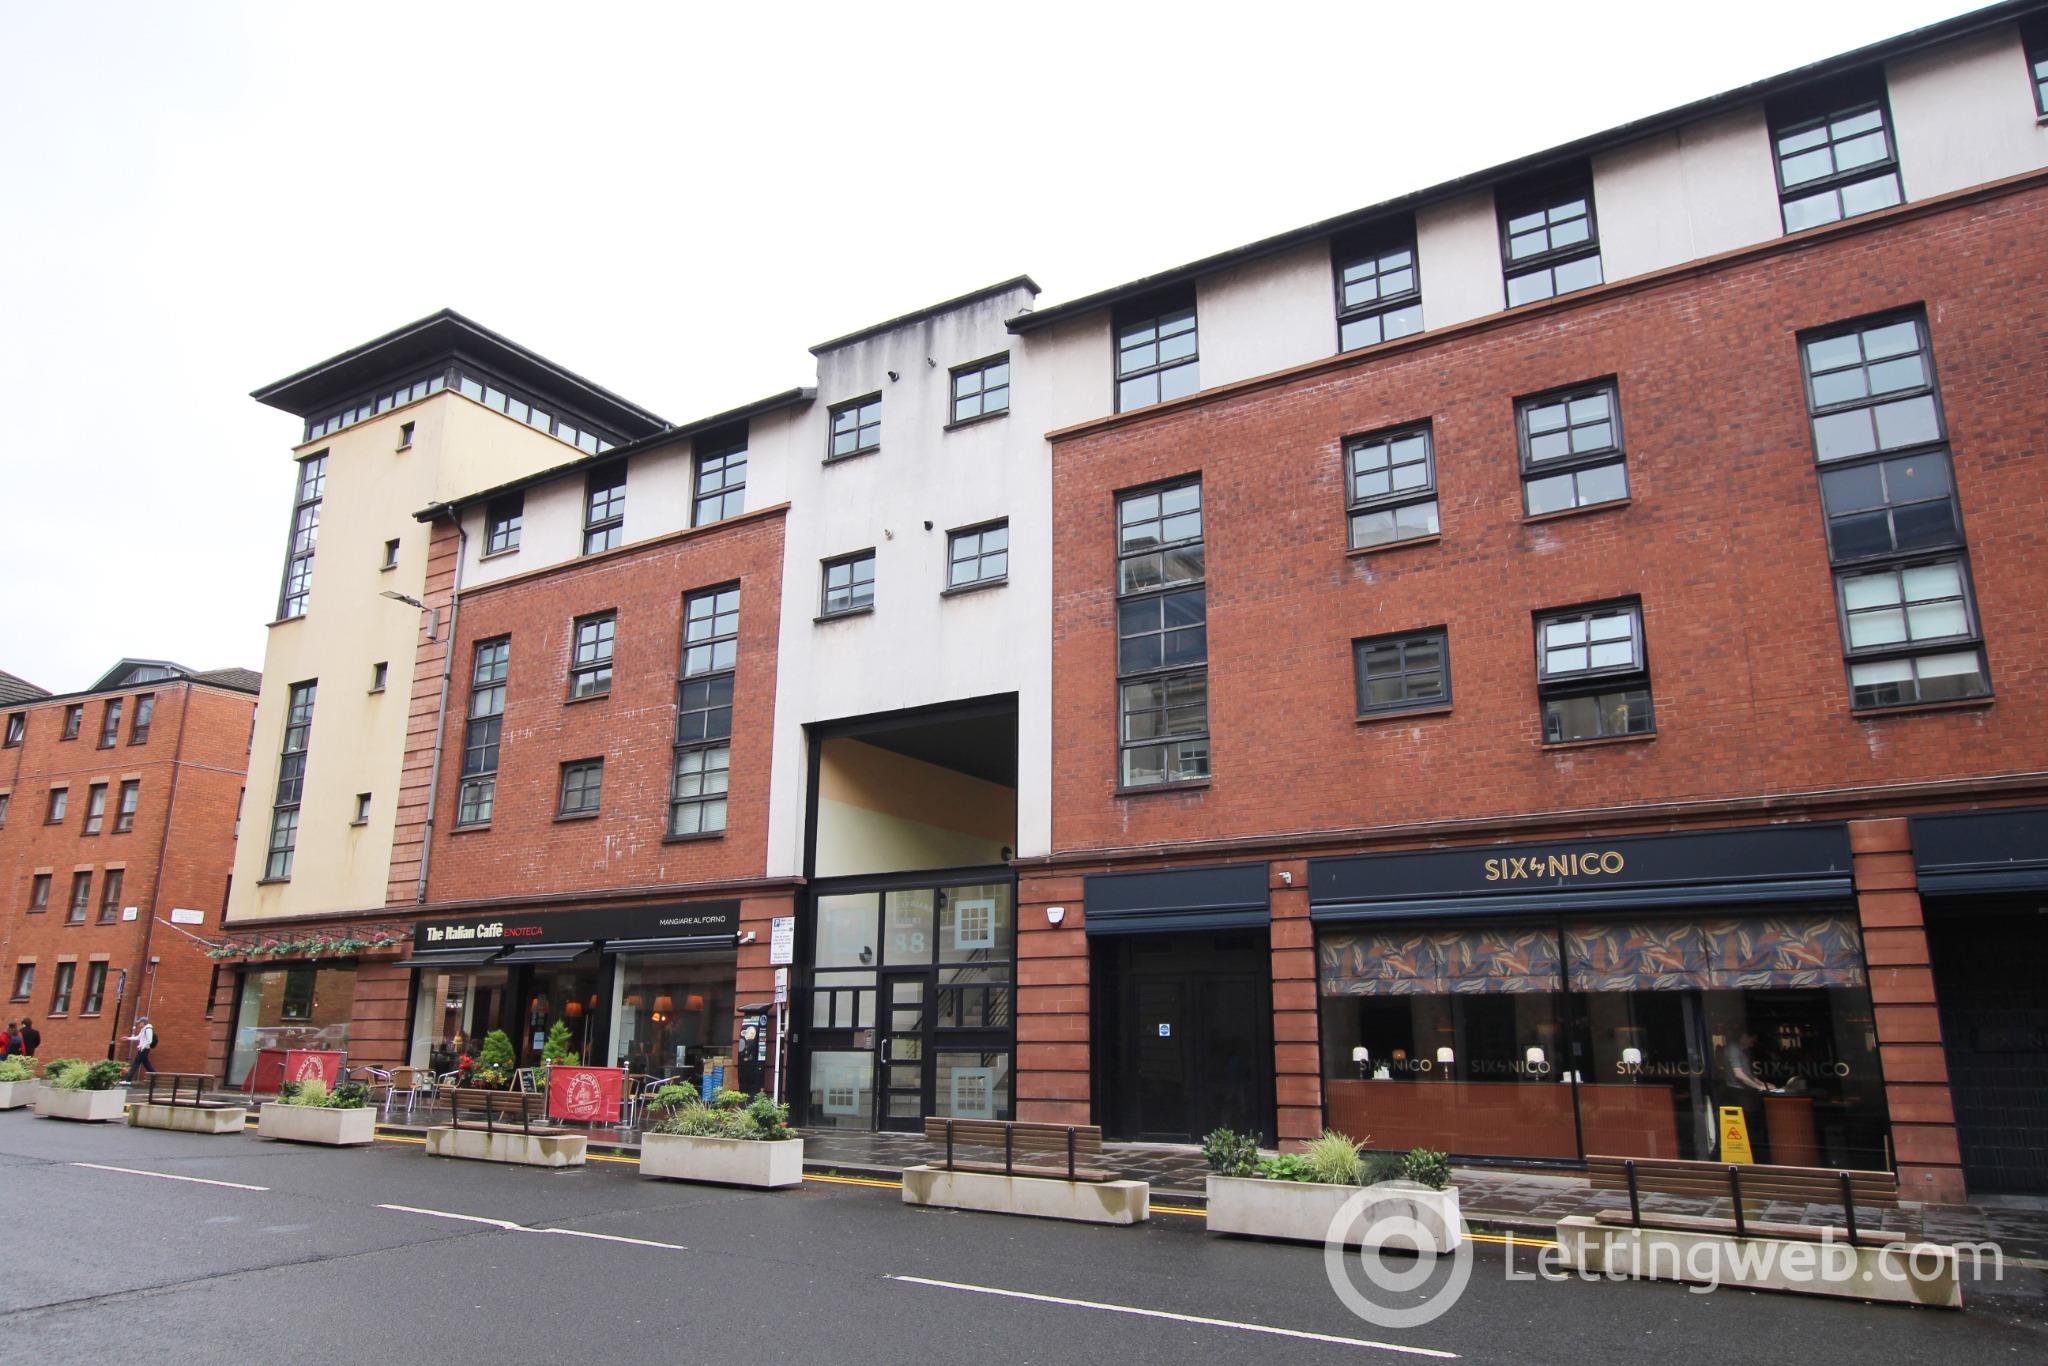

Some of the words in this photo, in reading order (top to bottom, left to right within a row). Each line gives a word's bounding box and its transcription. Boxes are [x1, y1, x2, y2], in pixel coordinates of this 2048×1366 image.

[1485, 857, 1528, 880] SIX
[1530, 857, 1545, 877] by
[1548, 851, 1624, 877] NICO
[427, 927, 444, 941] The
[445, 925, 475, 940] Italian
[504, 926, 543, 937] ENOTECA
[892, 932, 925, 954] 88
[1393, 1059, 1432, 1072] NICO
[1509, 1060, 1550, 1074] NICO
[1616, 1061, 1643, 1075] SIX
